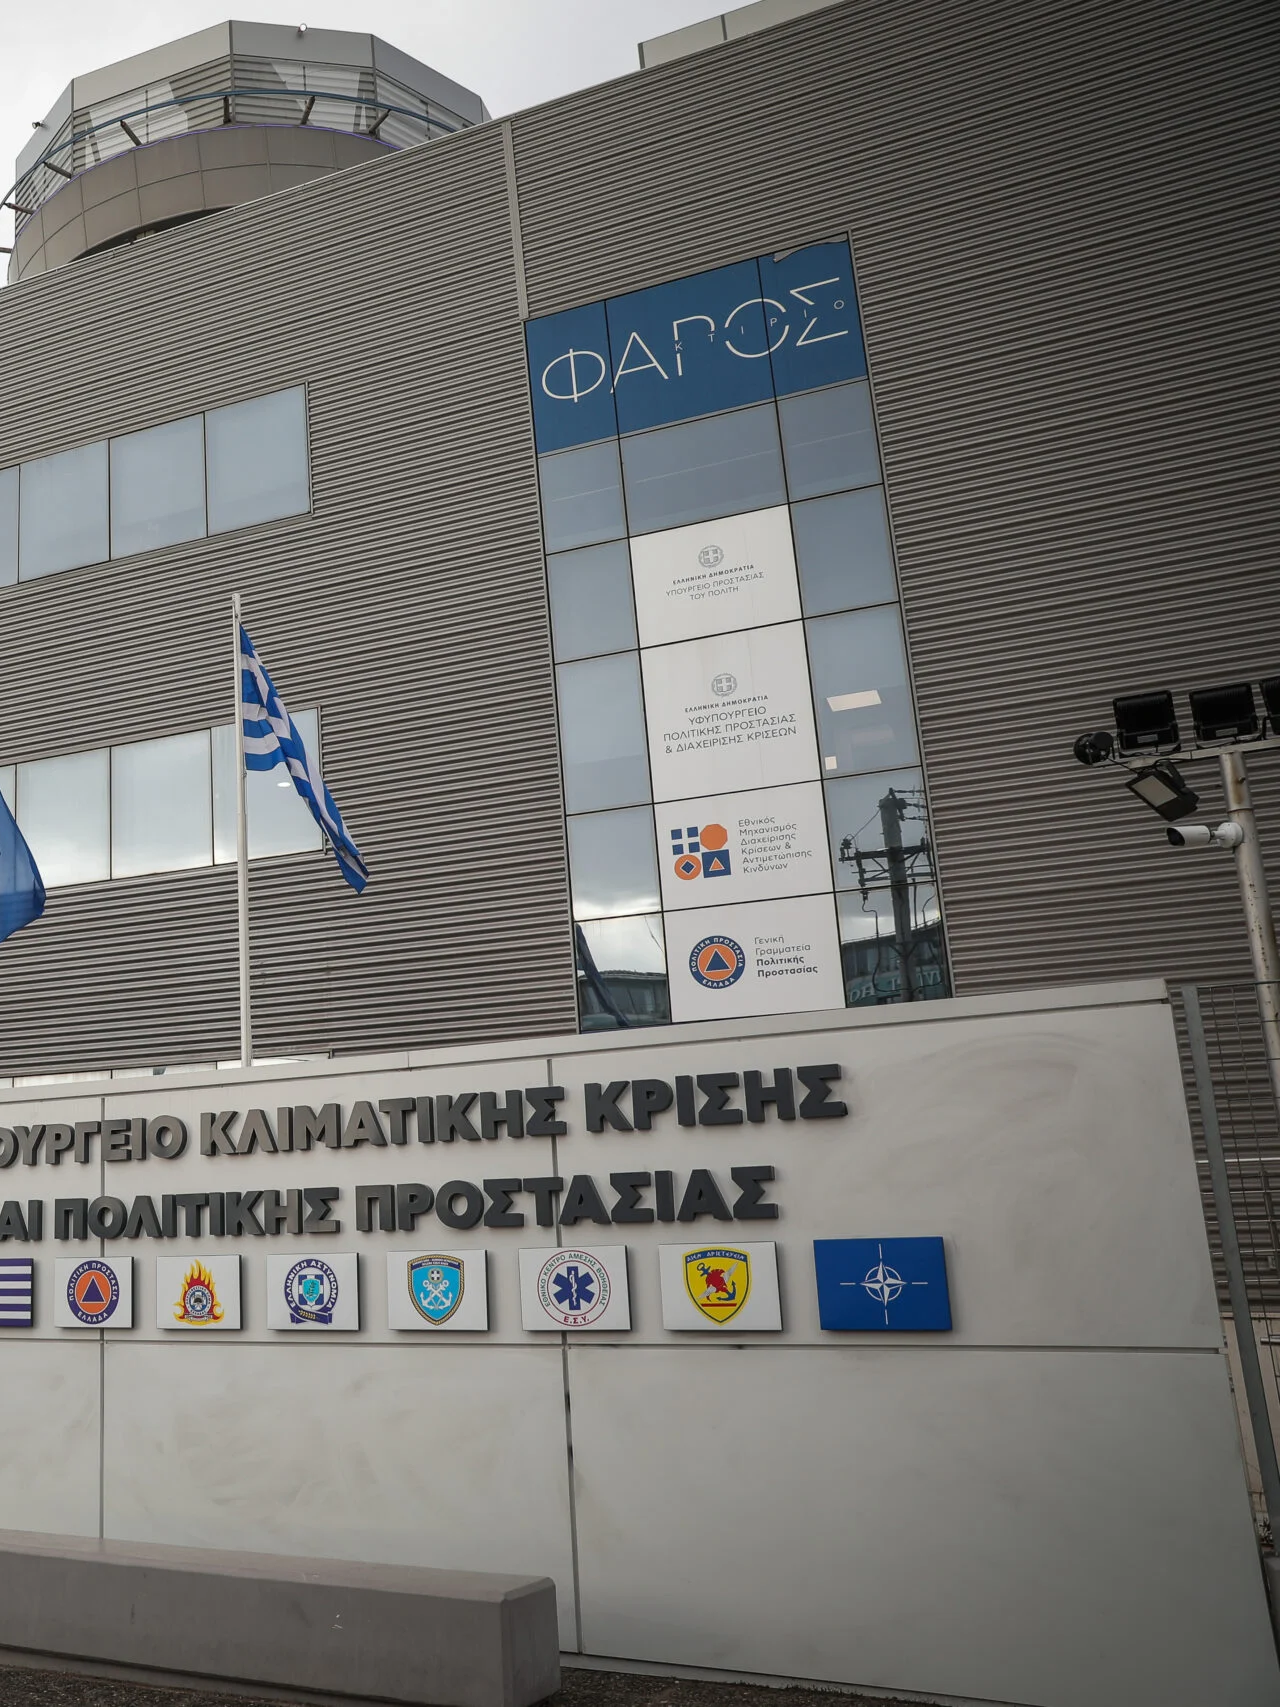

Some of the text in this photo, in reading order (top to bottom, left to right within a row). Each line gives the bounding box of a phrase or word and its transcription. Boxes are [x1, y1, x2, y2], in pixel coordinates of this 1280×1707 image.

[541, 277, 849, 403] ΦΑΡΟΣ
[708, 564, 754, 578] ΔΗΜΟΚΡΑΤΙΑ
[666, 571, 765, 597] ΥΠΟΥΡΓΕΙΟ ΠΡΟΣΤΑΣΙΑΣ
[690, 585, 739, 600] ΤΟΥ ΠΟΛΙΤΗ
[684, 694, 769, 713] ΕΛΛΗΝΙΚΗ ΔΗΜΟΚΡΑΤΙΑ
[688, 705, 767, 726] ΥΦΥΠΟΥΡΓΕΙΟ
[663, 713, 796, 742] ΠΟΛΙΤΙΚΗΣ ΠΡΟΣΤΑΣΙΑΣ
[665, 726, 797, 754] & ΔΙΑΧΕΙΡΙΣΗΣ ΚΡΙΣΕΩΝ
[738, 815, 776, 828] Εθνικός
[739, 822, 798, 838] Μηχανισμός
[740, 832, 797, 846] Διαχείρισης
[741, 841, 792, 856] Κρίσεων &
[742, 849, 813, 865] Αντιμετώπισης
[743, 861, 789, 874] Κινδύνων
[754, 935, 785, 945] Γενική
[691, 937, 743, 972] ΠΟΛΙΤΙΚΗ ΠΡΟΣΤΑΣΙΑ
[755, 943, 811, 956] Γραμματεία
[756, 955, 805, 967] Πολιτικής
[757, 965, 818, 979] Προστασίας
[702, 977, 736, 988] ΕΛΛΑΔΑ
[200, 1085, 567, 1157] ΚΛΙΜΑΤΙΚΗΣ
[583, 1063, 849, 1132] ΚΡΙΣΗΣ
[54, 1187, 341, 1241] ΠΟΛΙΤΙΚΗΣ
[355, 1165, 779, 1232] ΠΡΟΣΤΑΣΙΑΣ
[68, 1262, 118, 1301] ΠΟΛΙΤΙΚΗ ΠΡΟΣΤΑΣΙΑ
[286, 1260, 337, 1308] ΕΛΛΗΝΙΚΗ ΑΣΤΥΝΟΜΙΑ
[540, 1253, 608, 1307] ΕΘΝΙΚΟ ΚΕΝΤΡΟ ΑΜΕΣΗΣ ΒΟΗΘΕΙΑΣ
[77, 1311, 108, 1324] ΕΛΛΑΔΑ
[563, 1315, 590, 1324] Ε.Σ.Υ.
